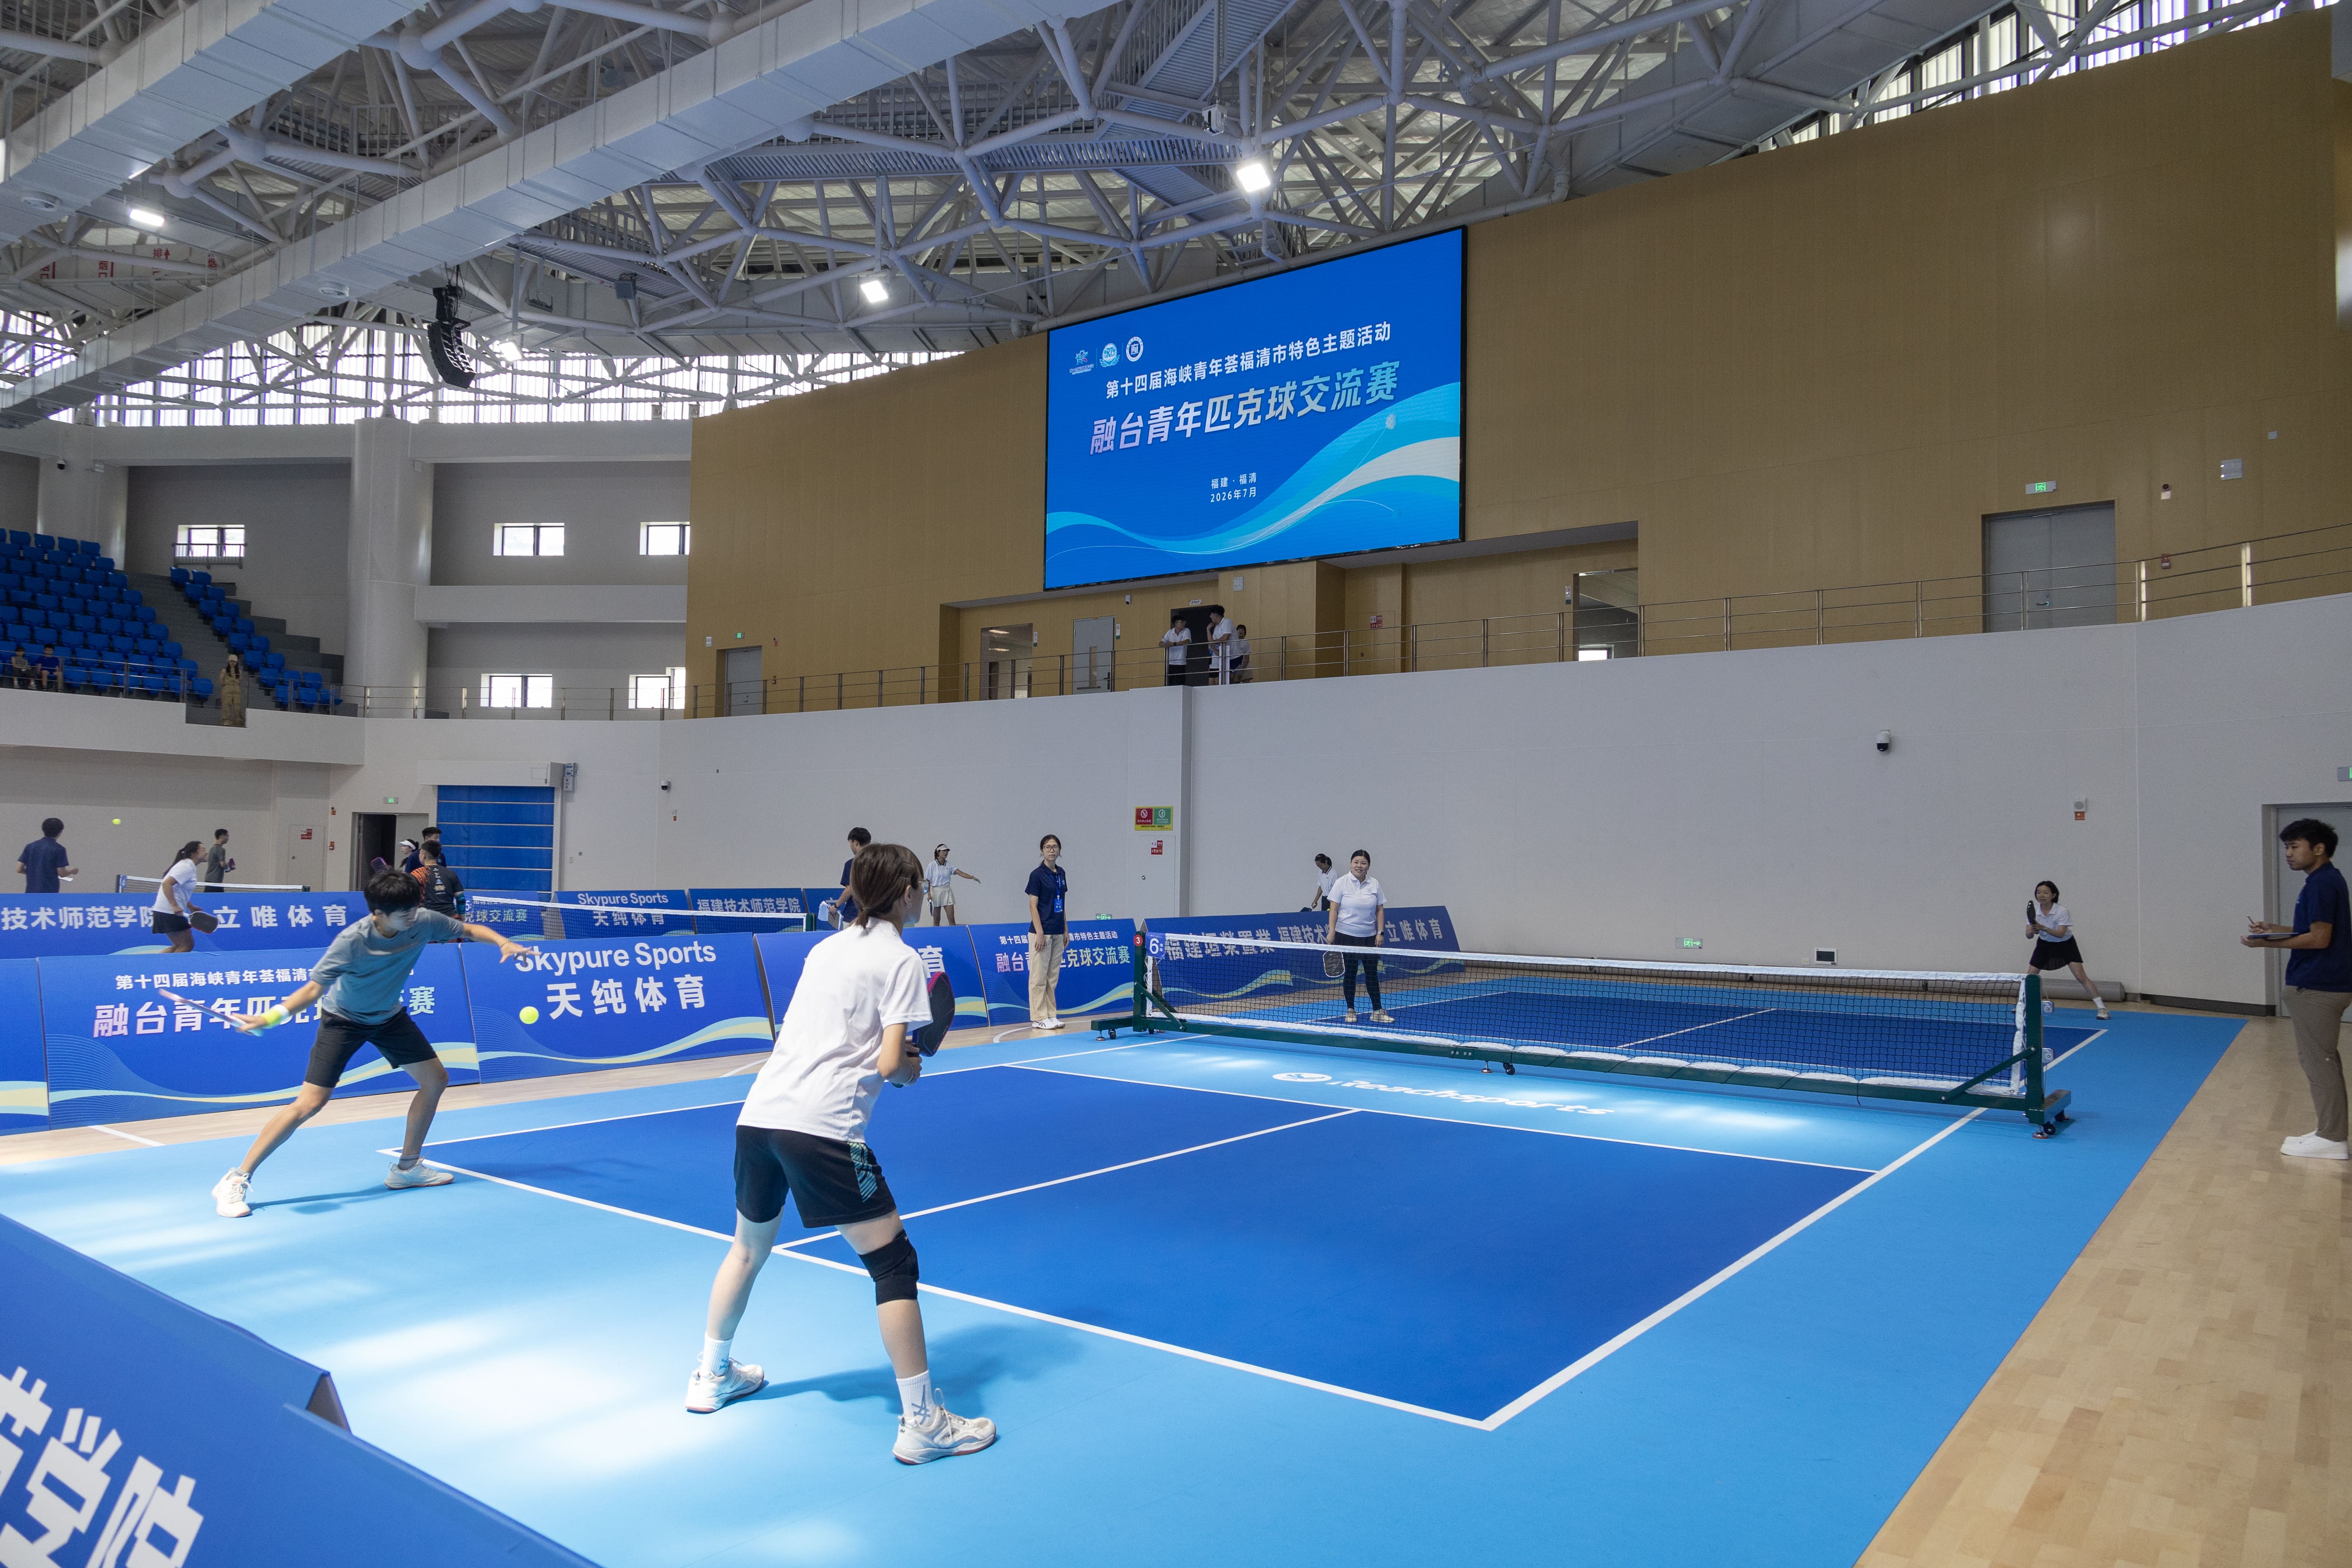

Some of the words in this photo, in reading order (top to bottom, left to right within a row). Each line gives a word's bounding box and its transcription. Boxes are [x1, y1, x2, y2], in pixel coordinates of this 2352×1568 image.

[1106, 321, 1390, 399] 第十四届海峡青年荟福清市特色主题活动
[1089, 361, 1400, 455] 融台青年匹克球交流赛
[1210, 487, 1256, 502] 2026年7月
[578, 893, 628, 906] Skypure
[631, 893, 668, 906] Sports
[697, 897, 801, 913] 福建技术师范学院
[213, 904, 347, 928] 立唯体育
[1385, 918, 1443, 943] 立唯体育
[1149, 938, 1159, 954] 6
[515, 945, 630, 976] Skypure
[635, 941, 716, 970] Sports
[547, 974, 705, 1020] 天纯体育
